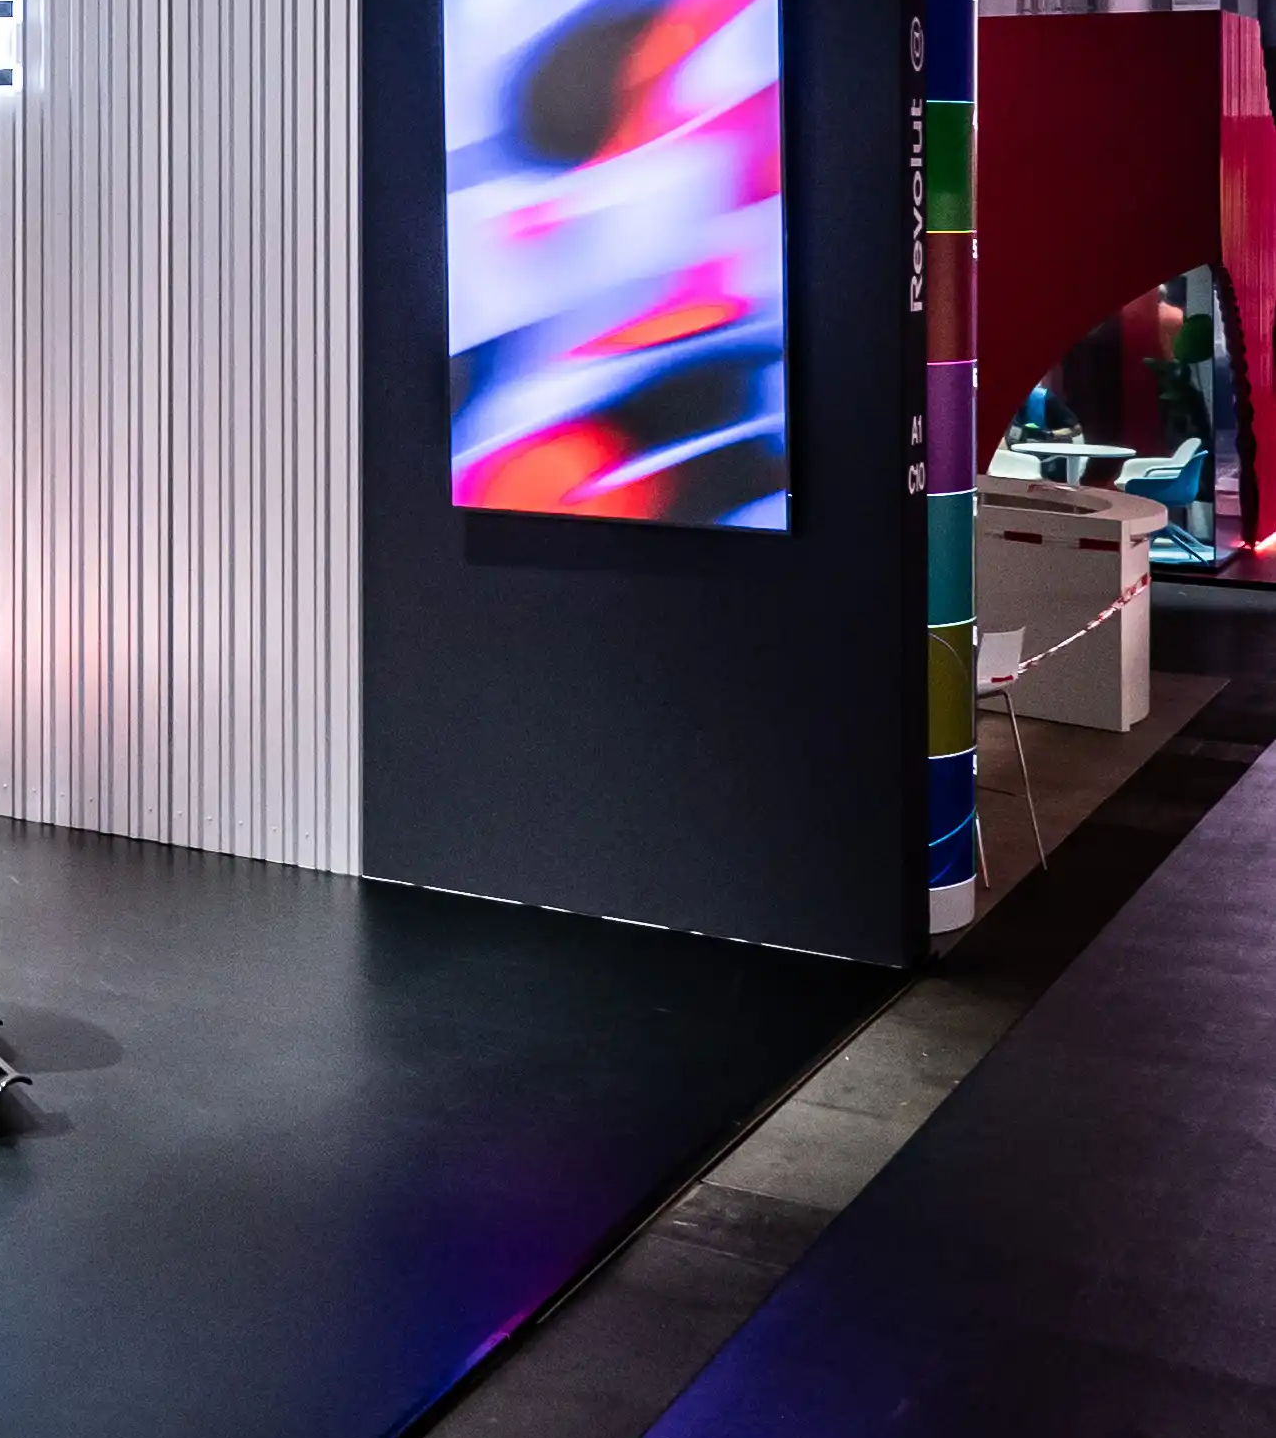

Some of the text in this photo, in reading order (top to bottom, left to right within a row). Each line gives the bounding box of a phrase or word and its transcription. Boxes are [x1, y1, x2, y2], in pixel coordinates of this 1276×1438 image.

[910, 16, 924, 73] @
[909, 98, 923, 313] Revolut
[911, 414, 923, 447] A1
[908, 461, 925, 496] C10
